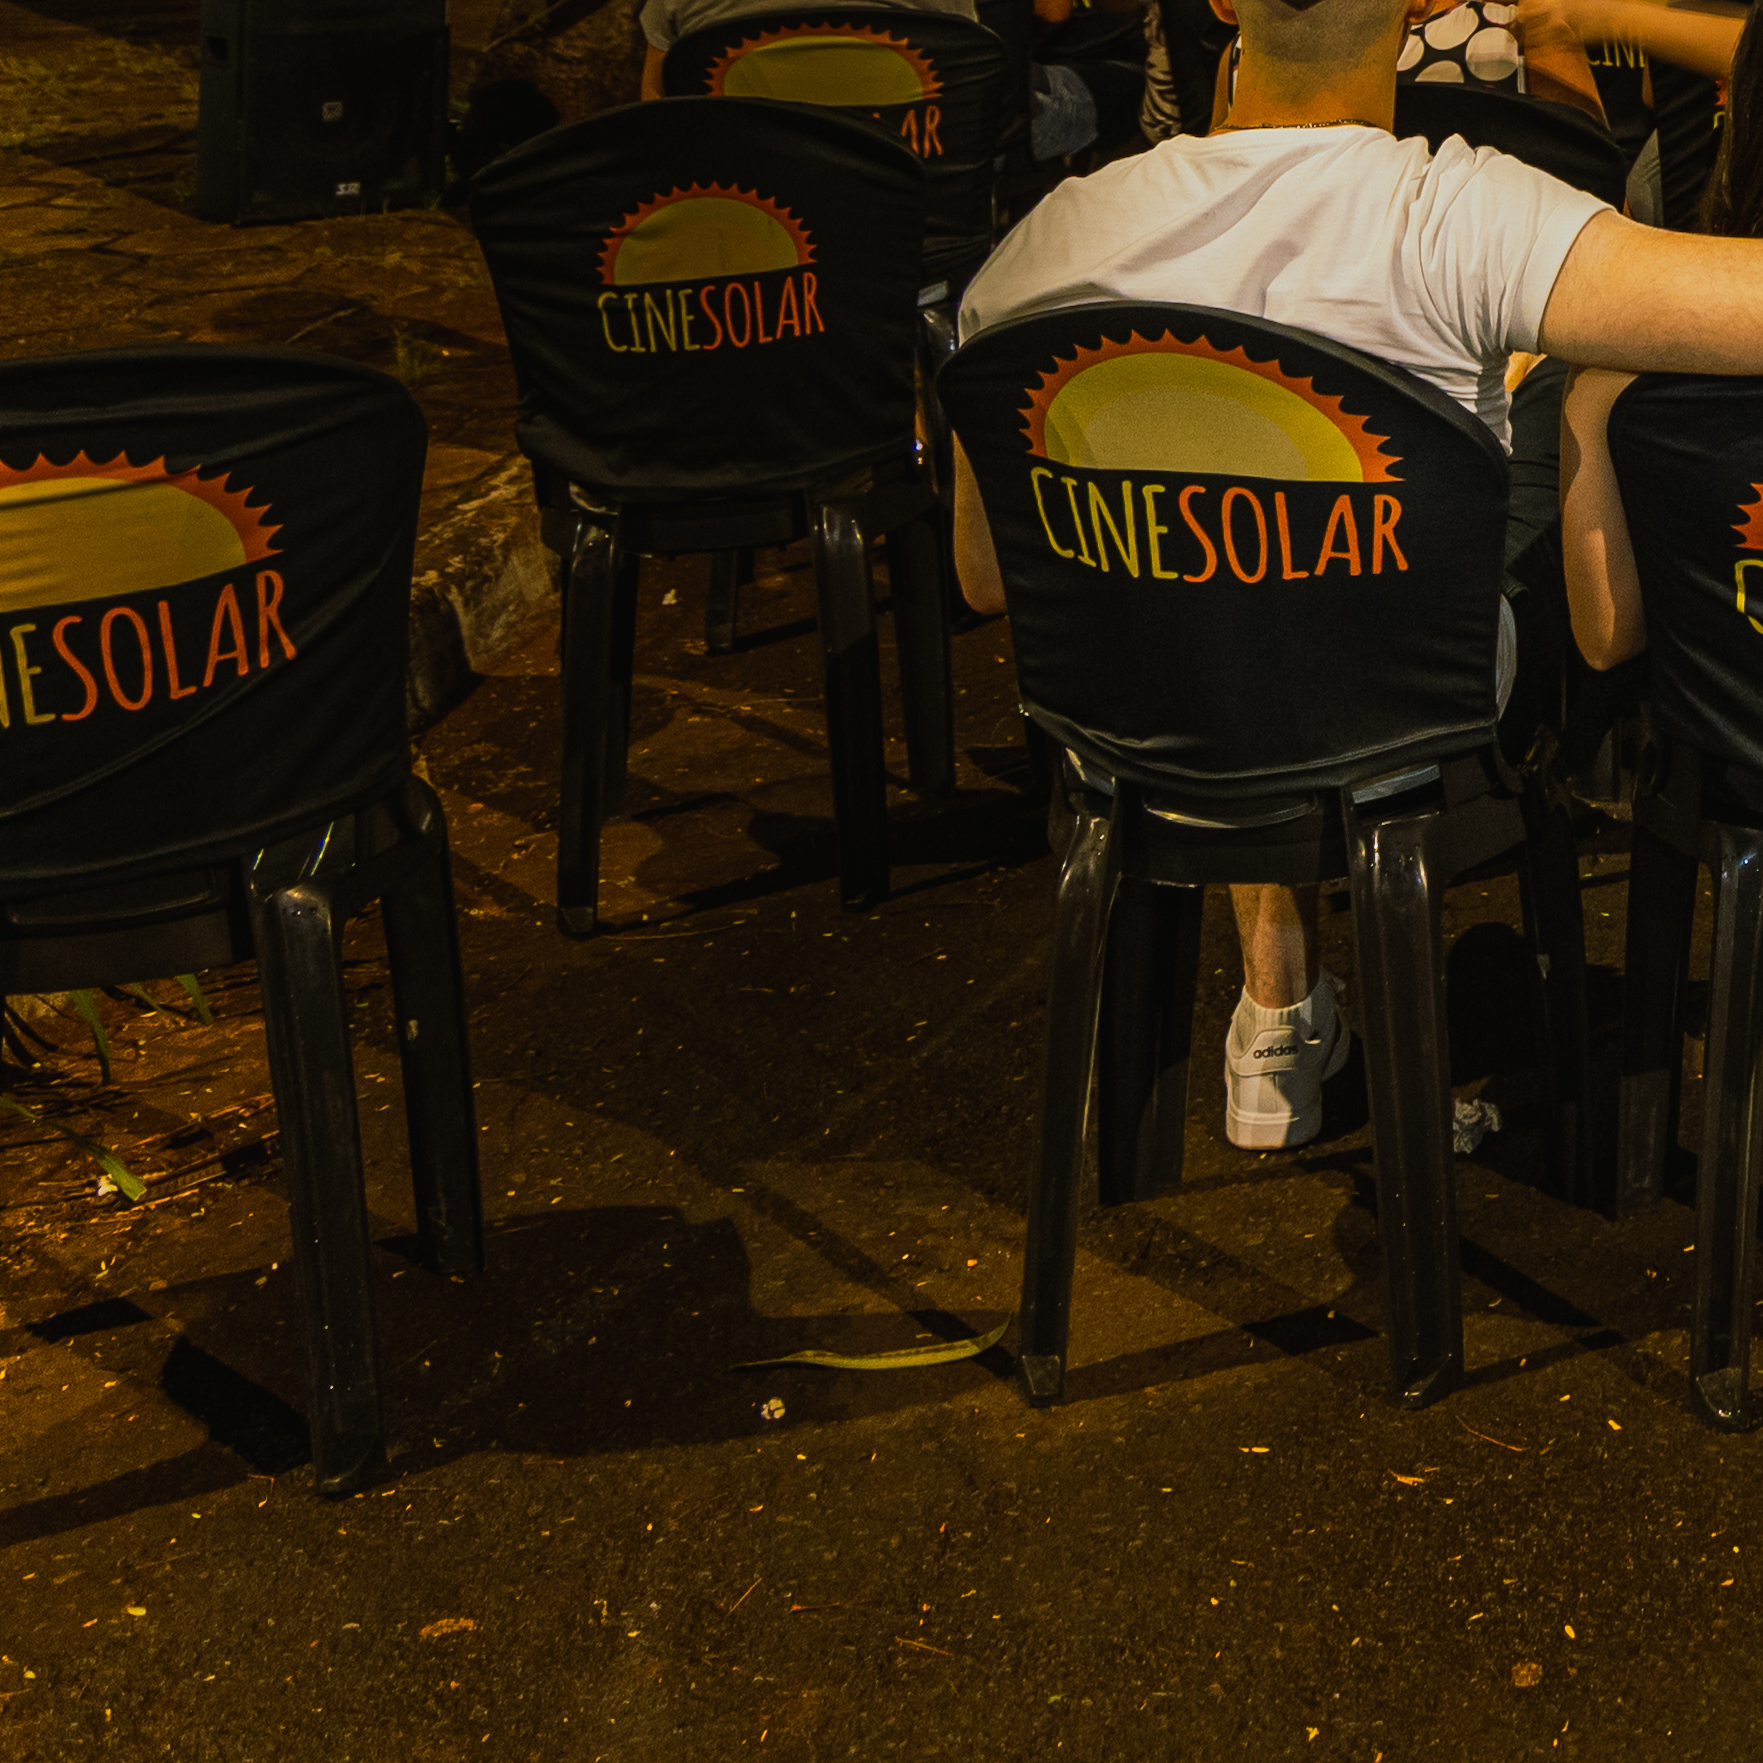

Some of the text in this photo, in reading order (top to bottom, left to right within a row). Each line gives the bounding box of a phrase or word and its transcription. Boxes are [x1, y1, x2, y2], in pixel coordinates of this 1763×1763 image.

[597, 271, 825, 353] CINESOLAR
[1029, 466, 1409, 584] CINESOLAR
[1253, 1044, 1299, 1059] adidas
